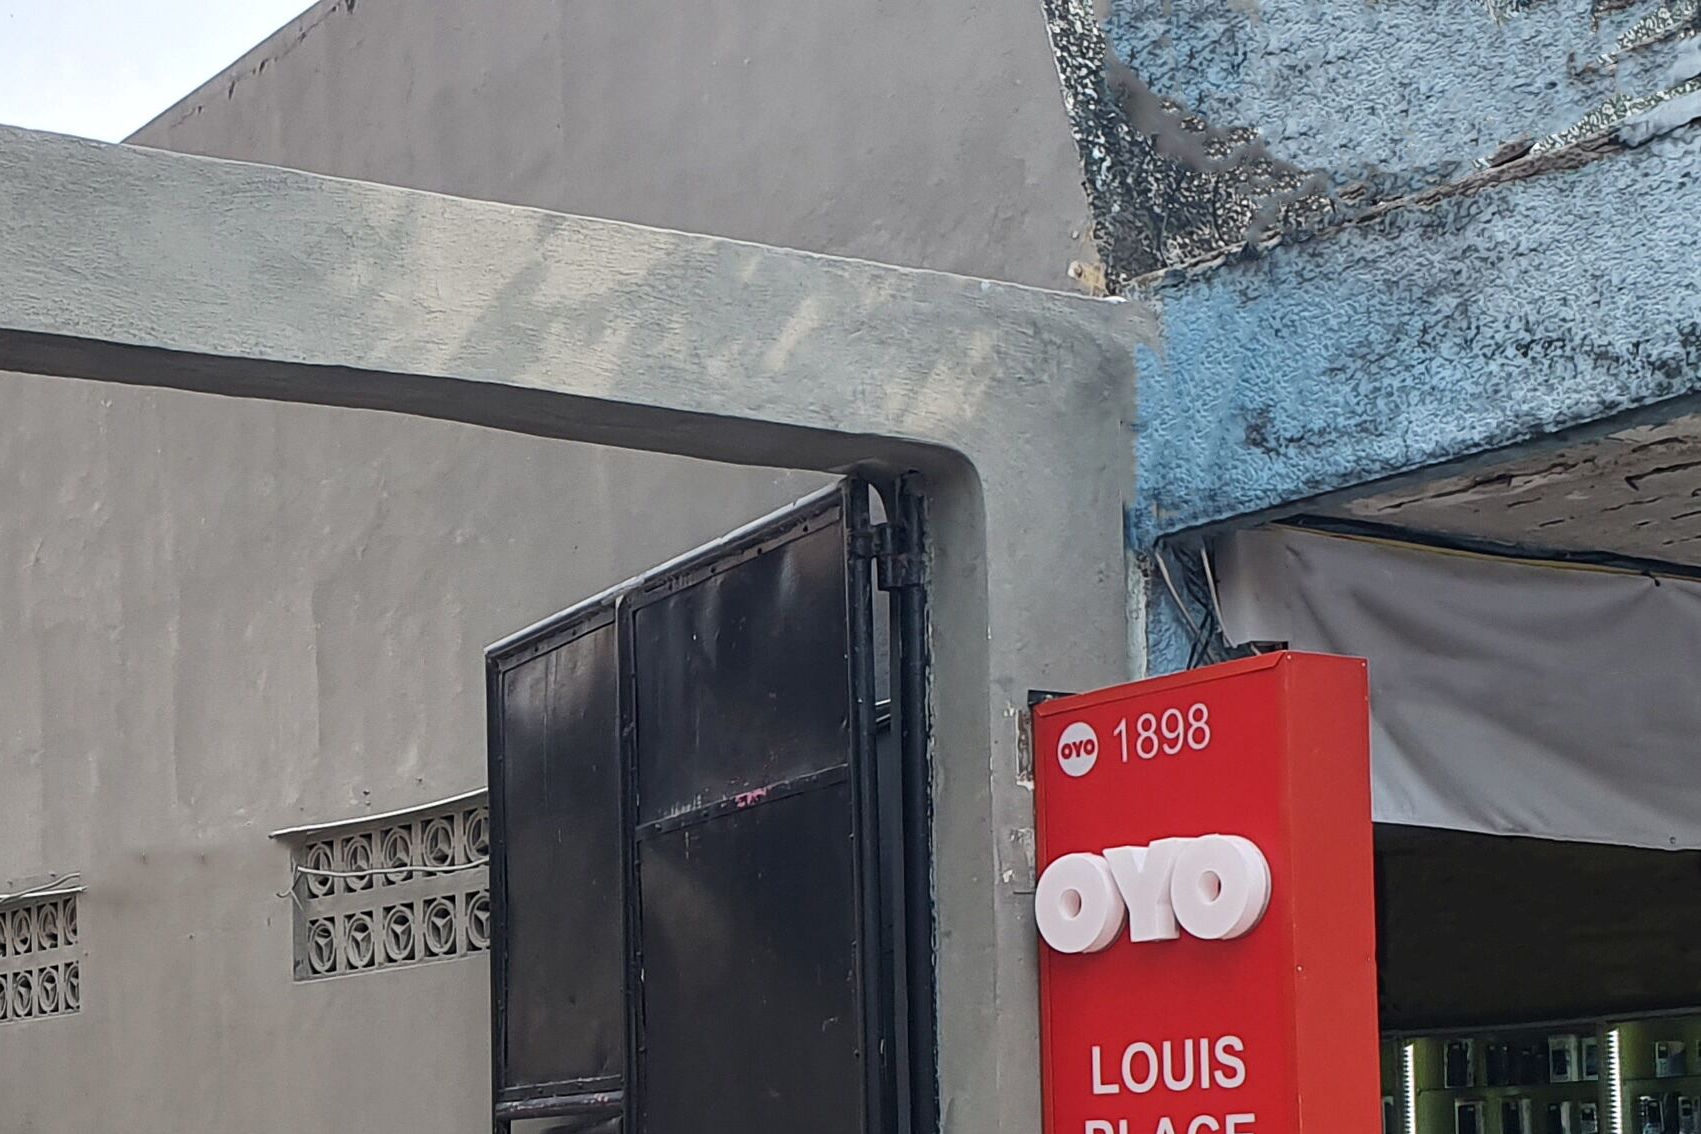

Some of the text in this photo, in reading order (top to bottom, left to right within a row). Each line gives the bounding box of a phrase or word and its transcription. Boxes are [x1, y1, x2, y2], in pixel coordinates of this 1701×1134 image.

[1060, 703, 1211, 763] OYO 1898
[1035, 833, 1272, 954] OYO
[1091, 1034, 1247, 1095] LOUIS
